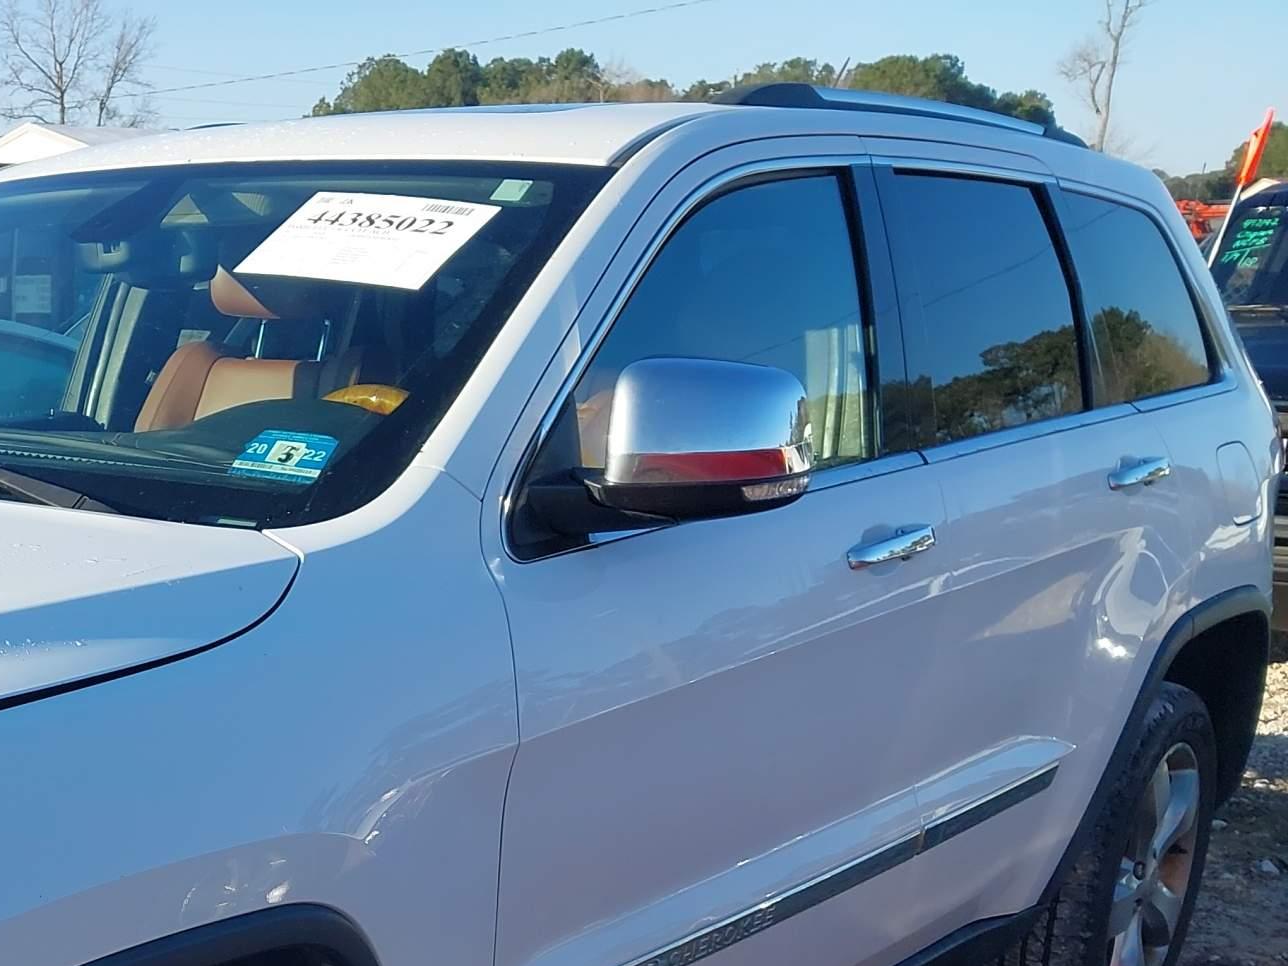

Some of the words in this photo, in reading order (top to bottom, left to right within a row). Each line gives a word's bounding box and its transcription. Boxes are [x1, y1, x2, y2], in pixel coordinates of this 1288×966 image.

[307, 210, 454, 235] 44385022
[246, 442, 268, 454] 20
[277, 445, 299, 463] 5
[302, 447, 326, 462] 22
